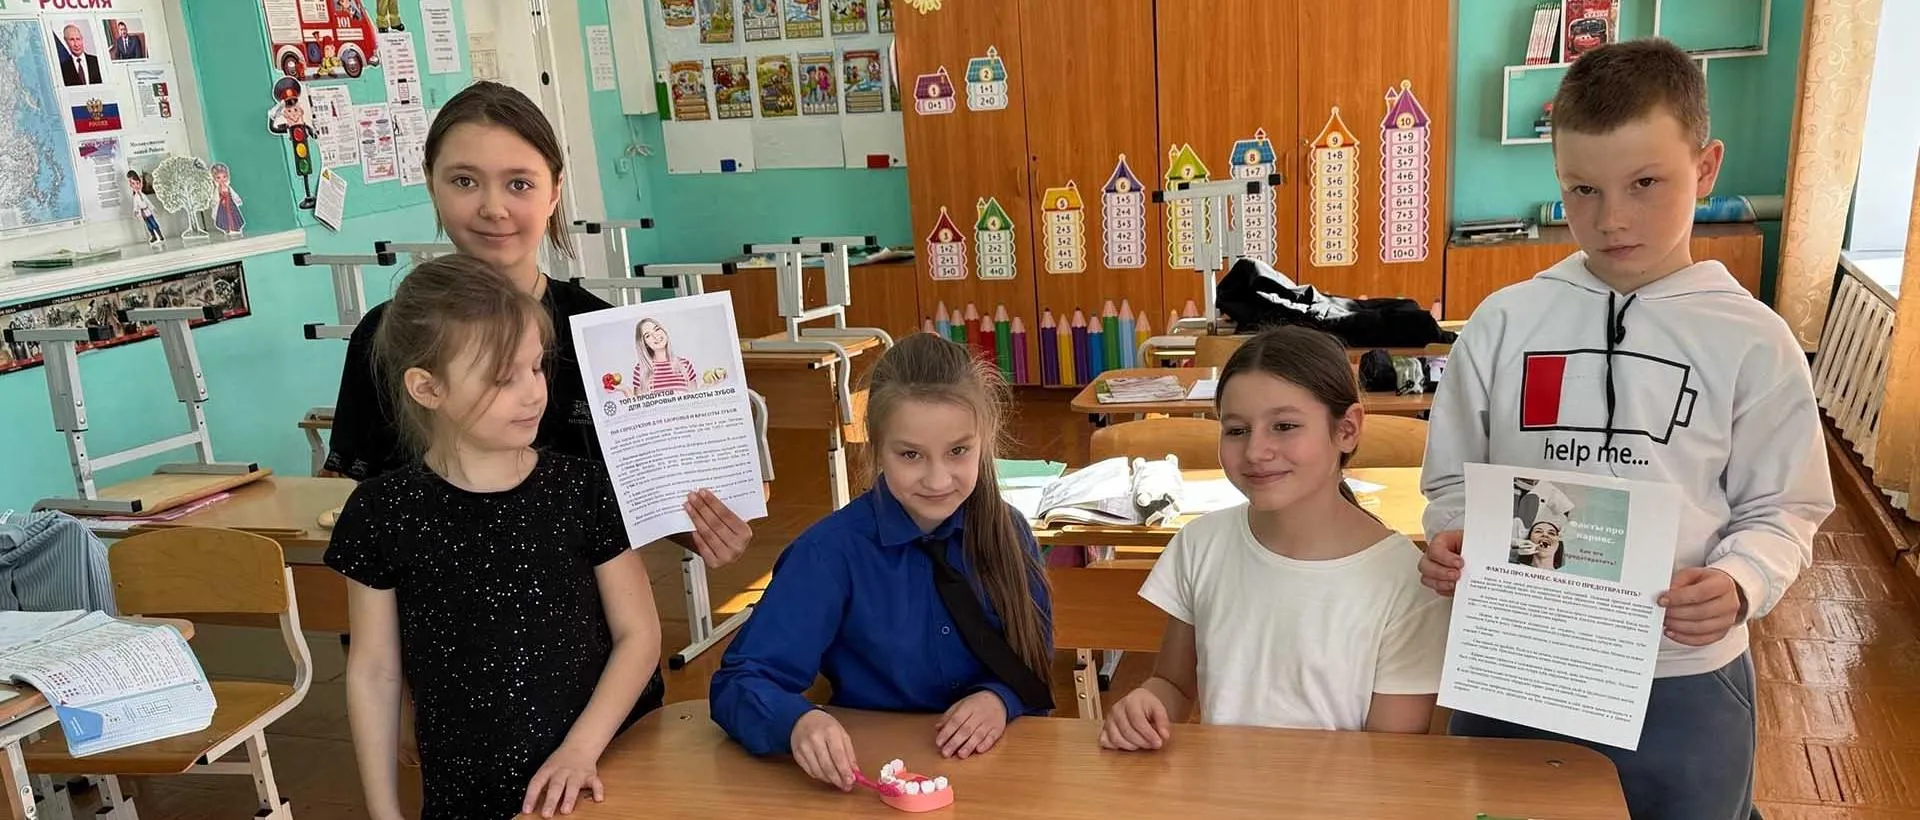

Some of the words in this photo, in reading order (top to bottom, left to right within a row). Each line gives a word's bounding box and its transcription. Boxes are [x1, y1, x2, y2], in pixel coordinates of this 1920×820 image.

[336, 16, 351, 28] 101
[983, 71, 989, 79] 2
[980, 85, 993, 93] 1+1
[928, 101, 942, 109] 0+1
[980, 97, 995, 106] 2+0
[1400, 117, 1411, 126] 10
[1397, 132, 1414, 141] 1+9
[1396, 145, 1414, 154] 2+8
[1249, 153, 1255, 162] 8
[1327, 151, 1343, 159] 1+8
[1396, 158, 1414, 167] 3+7
[1185, 168, 1191, 176] 7
[1246, 168, 1260, 176] 1+7
[1326, 164, 1343, 172] 2+7
[1396, 172, 1414, 180] 4+6
[1326, 177, 1343, 185] 3+6
[1120, 182, 1126, 190] 6
[1396, 185, 1414, 194] 5+5
[1326, 190, 1343, 198] 4+5
[1059, 199, 1065, 208] 5
[1116, 196, 1131, 204] 1+5
[1396, 198, 1413, 207] 6+4
[1246, 206, 1261, 214] 4+4
[1326, 203, 1342, 211] 5+4
[1116, 208, 1131, 216] 2+4
[1396, 211, 1413, 219] 7+3
[1056, 214, 1071, 222] 1+4
[1246, 218, 1261, 226] 5+3
[1326, 216, 1342, 224] 6+3
[1117, 220, 1131, 228] 3+3
[1396, 223, 1413, 232] 8+2
[1056, 226, 1072, 234] 2+3
[1326, 228, 1342, 236] 7+2
[988, 233, 1001, 241] 1+3
[1117, 232, 1131, 240] 4+2
[1247, 230, 1262, 239] 6+2
[1057, 237, 1072, 246] 3+2
[1396, 236, 1413, 245] 9+1
[940, 245, 953, 253] 1+2
[988, 244, 1002, 252] 2+2
[1117, 244, 1131, 252] 5+1
[1247, 243, 1261, 251] 7+1
[1326, 241, 1342, 249] 8+1
[1058, 249, 1072, 257] 4+1
[1393, 249, 1414, 258] 10+0
[941, 256, 954, 264] 2+1
[989, 256, 1002, 264] 3+1
[1117, 255, 1132, 264] 6+0
[1326, 254, 1343, 262] 9+0
[1058, 261, 1073, 269] 5+0
[942, 267, 956, 276] 3+0
[990, 267, 1004, 275] 4+0
[619, 397, 632, 405] ТОП
[637, 390, 674, 401] ПРОДУКТОВ
[628, 403, 641, 411] ДЛЯ
[642, 396, 676, 408] ЗДОРОВЬЯ
[683, 391, 713, 400] КРАСОТЫ
[714, 387, 735, 396] ЗУБОВ
[1544, 437, 1590, 466] help
[1597, 446, 1649, 466] me...
[1606, 526, 1624, 535] про
[1485, 565, 1509, 574] ФАКТЫ
[1567, 579, 1581, 587] ЕГО
[1582, 582, 1641, 597] ПРЕДОТВРАТИТЬ?
